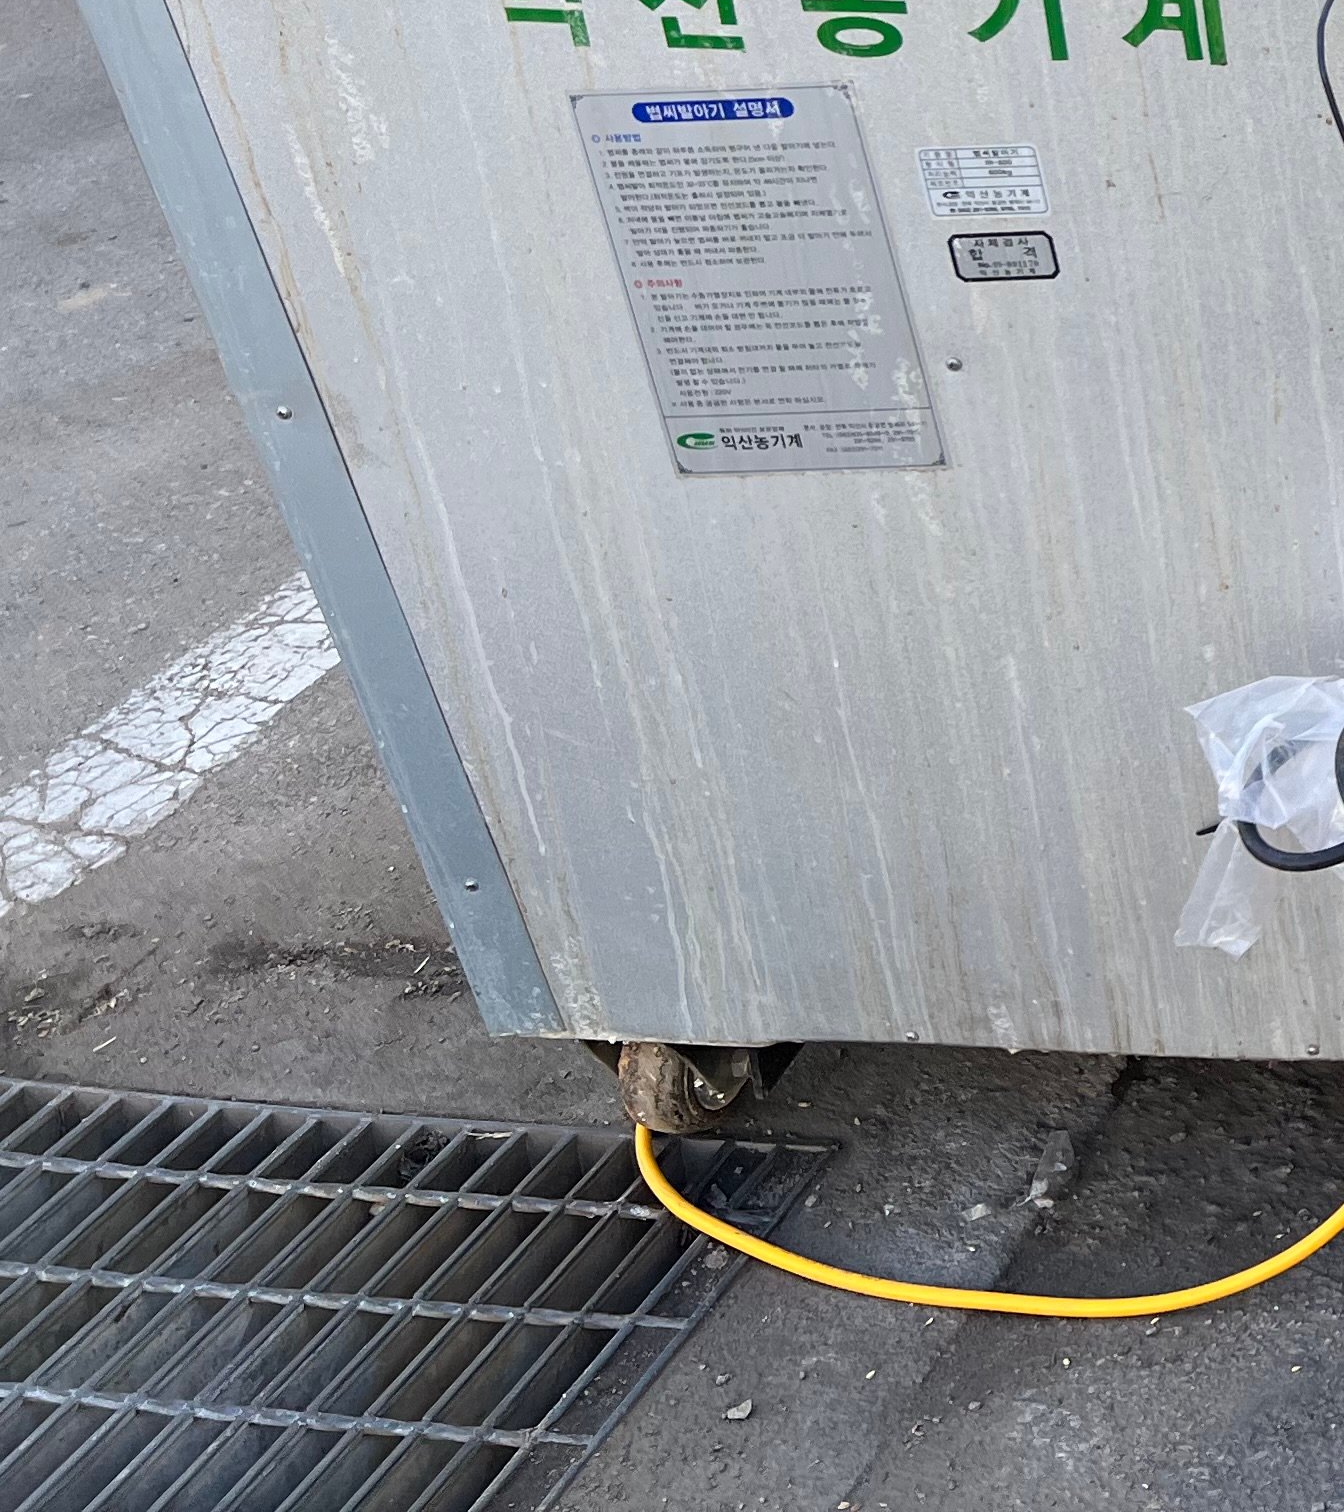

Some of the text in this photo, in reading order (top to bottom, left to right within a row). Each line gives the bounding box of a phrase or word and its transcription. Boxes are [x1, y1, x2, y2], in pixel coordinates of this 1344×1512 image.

[645, 100, 781, 121] 볍씨발아기 설명서
[721, 433, 803, 451] 익산농기계
